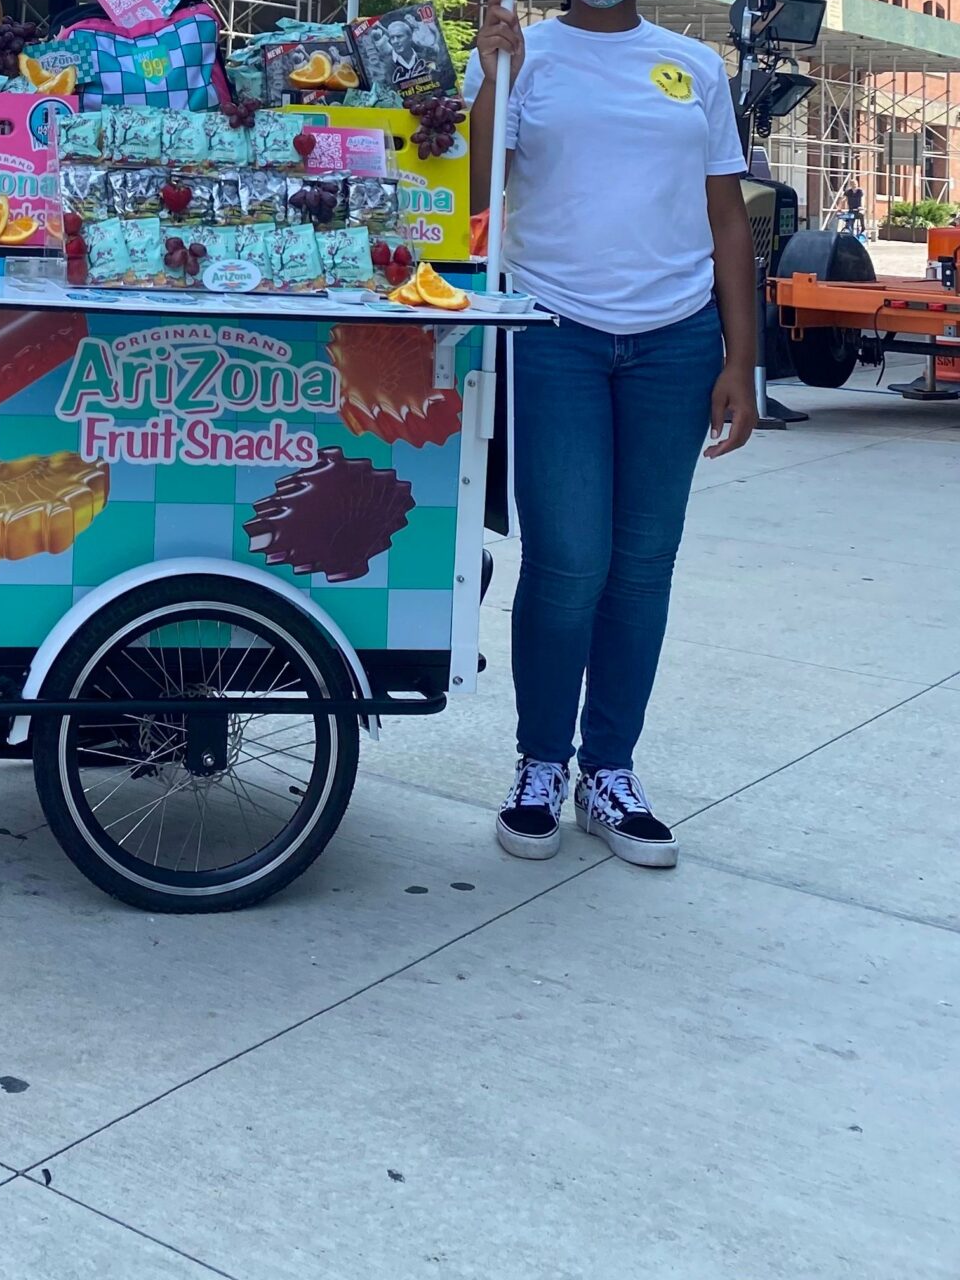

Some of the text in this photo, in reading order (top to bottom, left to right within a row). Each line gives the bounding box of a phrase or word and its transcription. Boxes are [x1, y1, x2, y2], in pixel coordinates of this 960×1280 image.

[417, 7, 433, 20] 10
[267, 45, 284, 60] NEW!
[397, 86, 415, 98] Fruit
[415, 81, 440, 93] Snacks
[211, 271, 253, 284] AriZona
[115, 329, 288, 357] ORIGINAL BRAND
[60, 341, 337, 416] AriZona
[86, 417, 314, 462] Fruit Snacks
